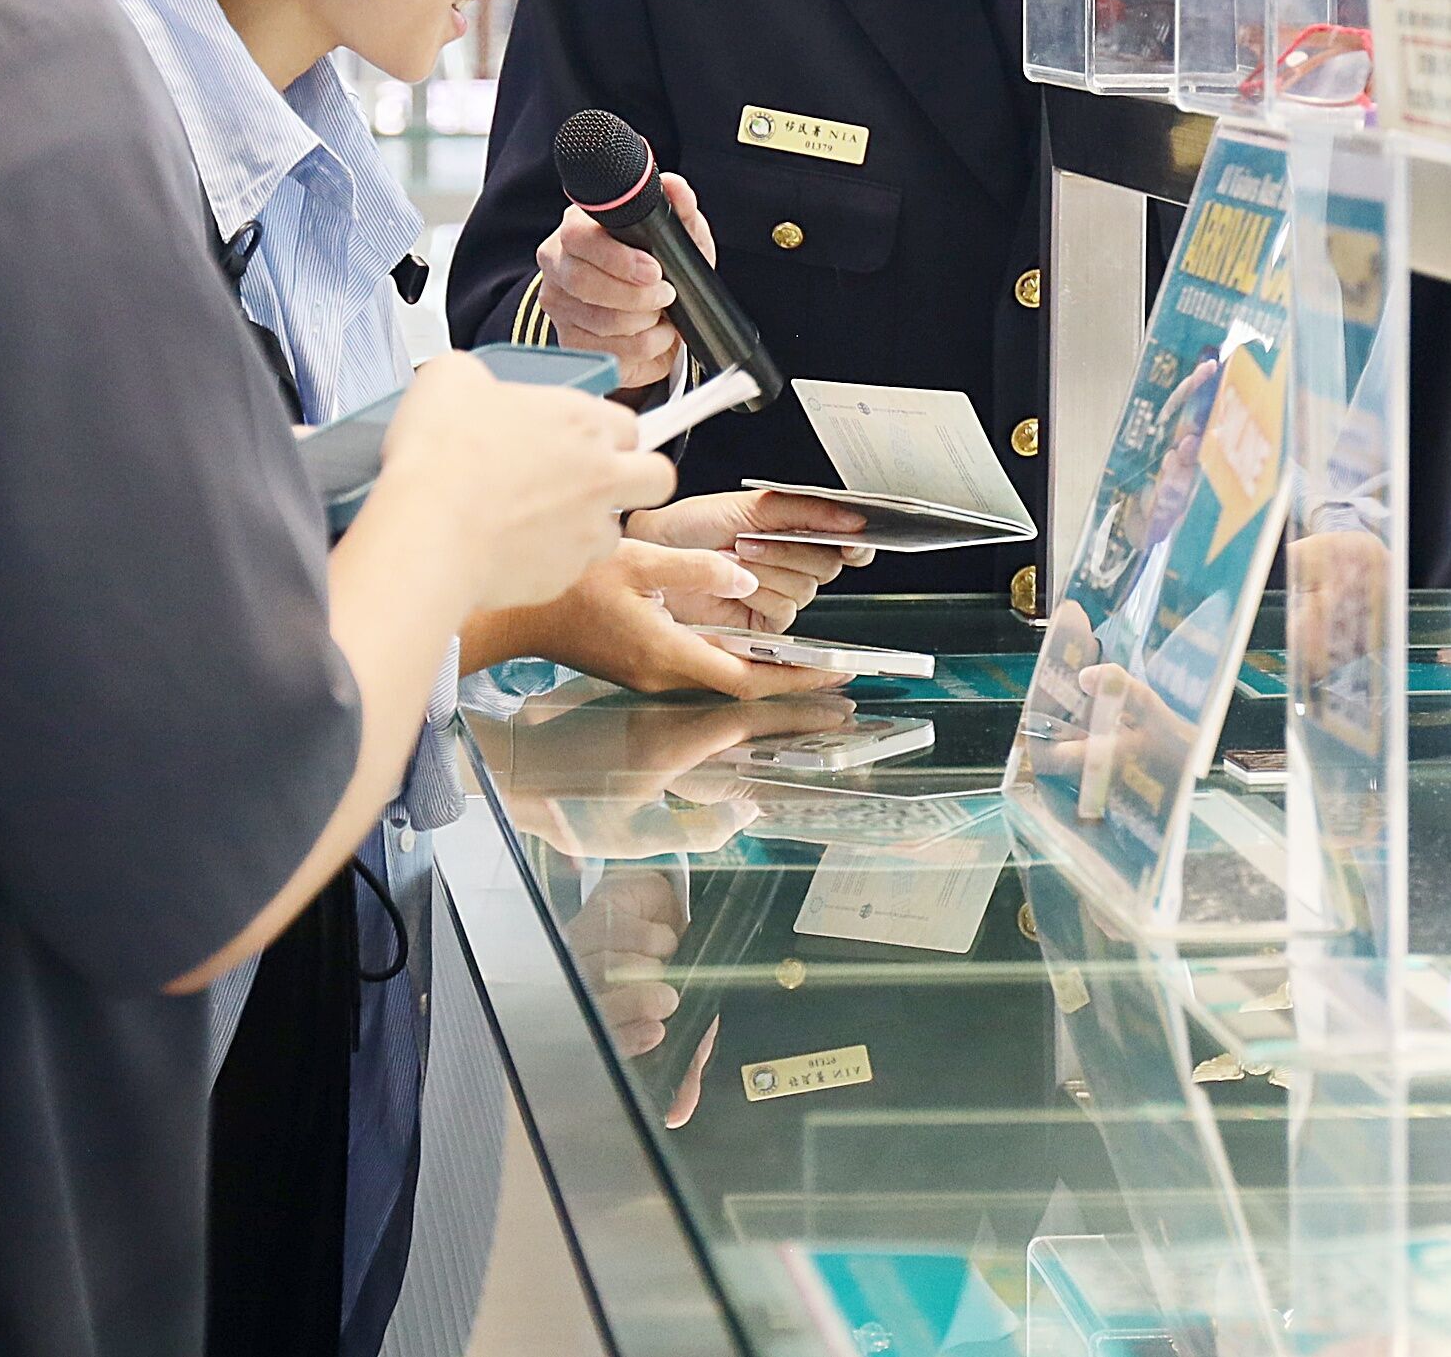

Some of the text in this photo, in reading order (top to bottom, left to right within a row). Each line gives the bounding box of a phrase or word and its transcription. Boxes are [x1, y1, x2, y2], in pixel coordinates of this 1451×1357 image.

[828, 130, 858, 144] NIA
[804, 140, 834, 152] 01379
[1180, 199, 1272, 296] ARRIVAL
